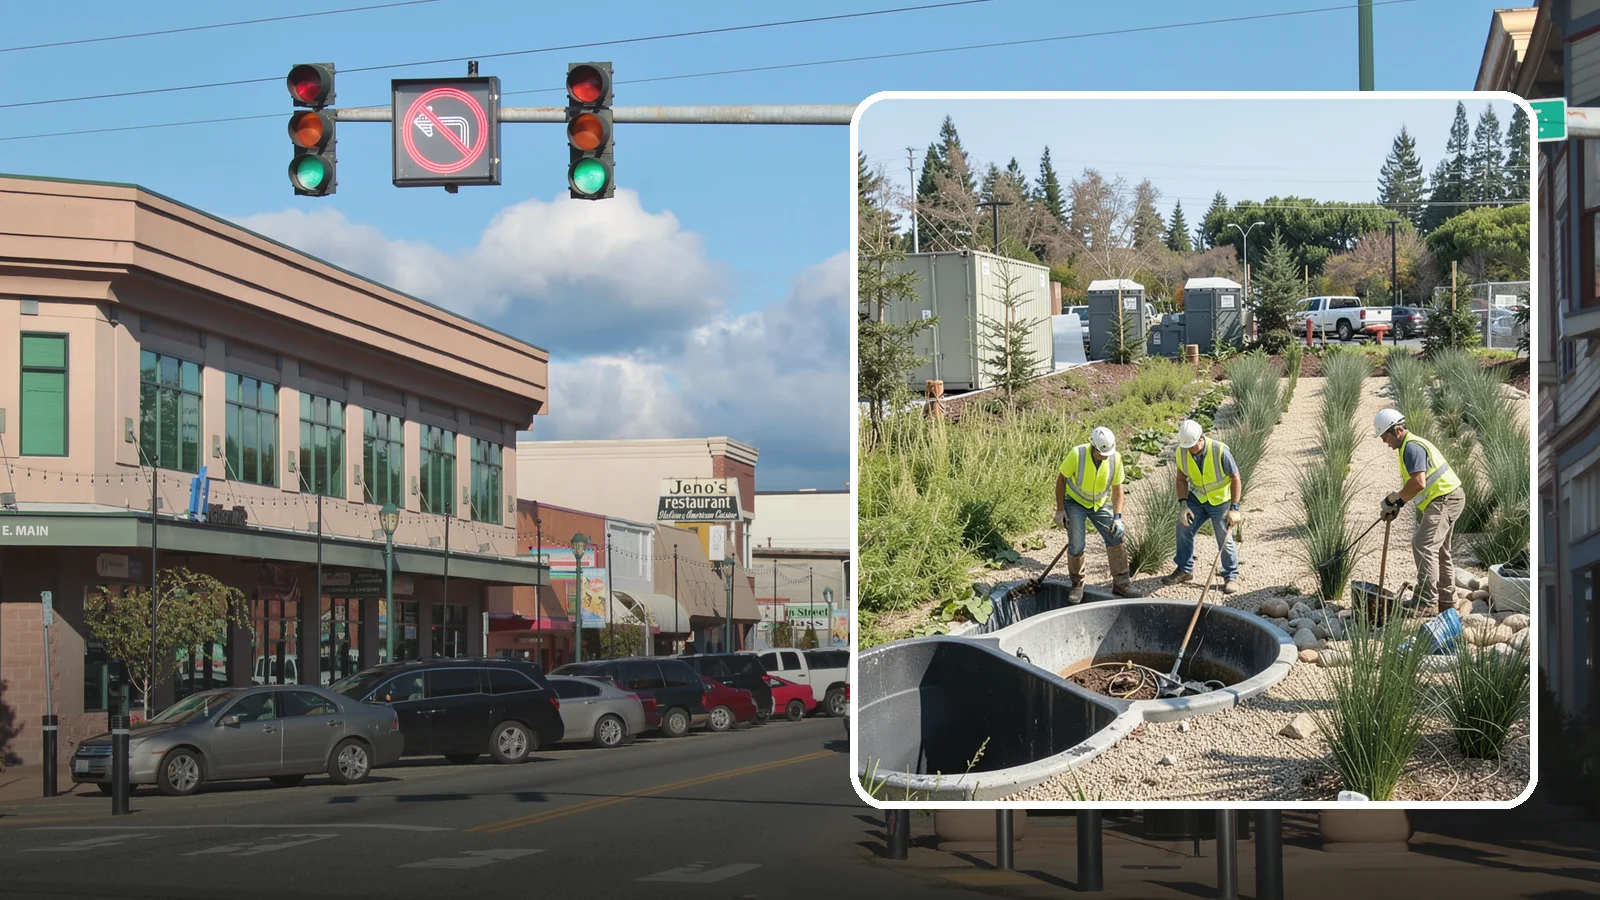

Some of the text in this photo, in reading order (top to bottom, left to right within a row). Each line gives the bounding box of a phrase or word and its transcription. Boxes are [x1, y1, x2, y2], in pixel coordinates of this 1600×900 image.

[669, 480, 727, 494] Jeno's
[665, 496, 731, 509] restaurant
[686, 510, 714, 519] American
[715, 509, 738, 519] Cuisine
[2, 525, 49, 536] E. MAIN
[797, 607, 828, 617] Street
[791, 619, 824, 627] lass
